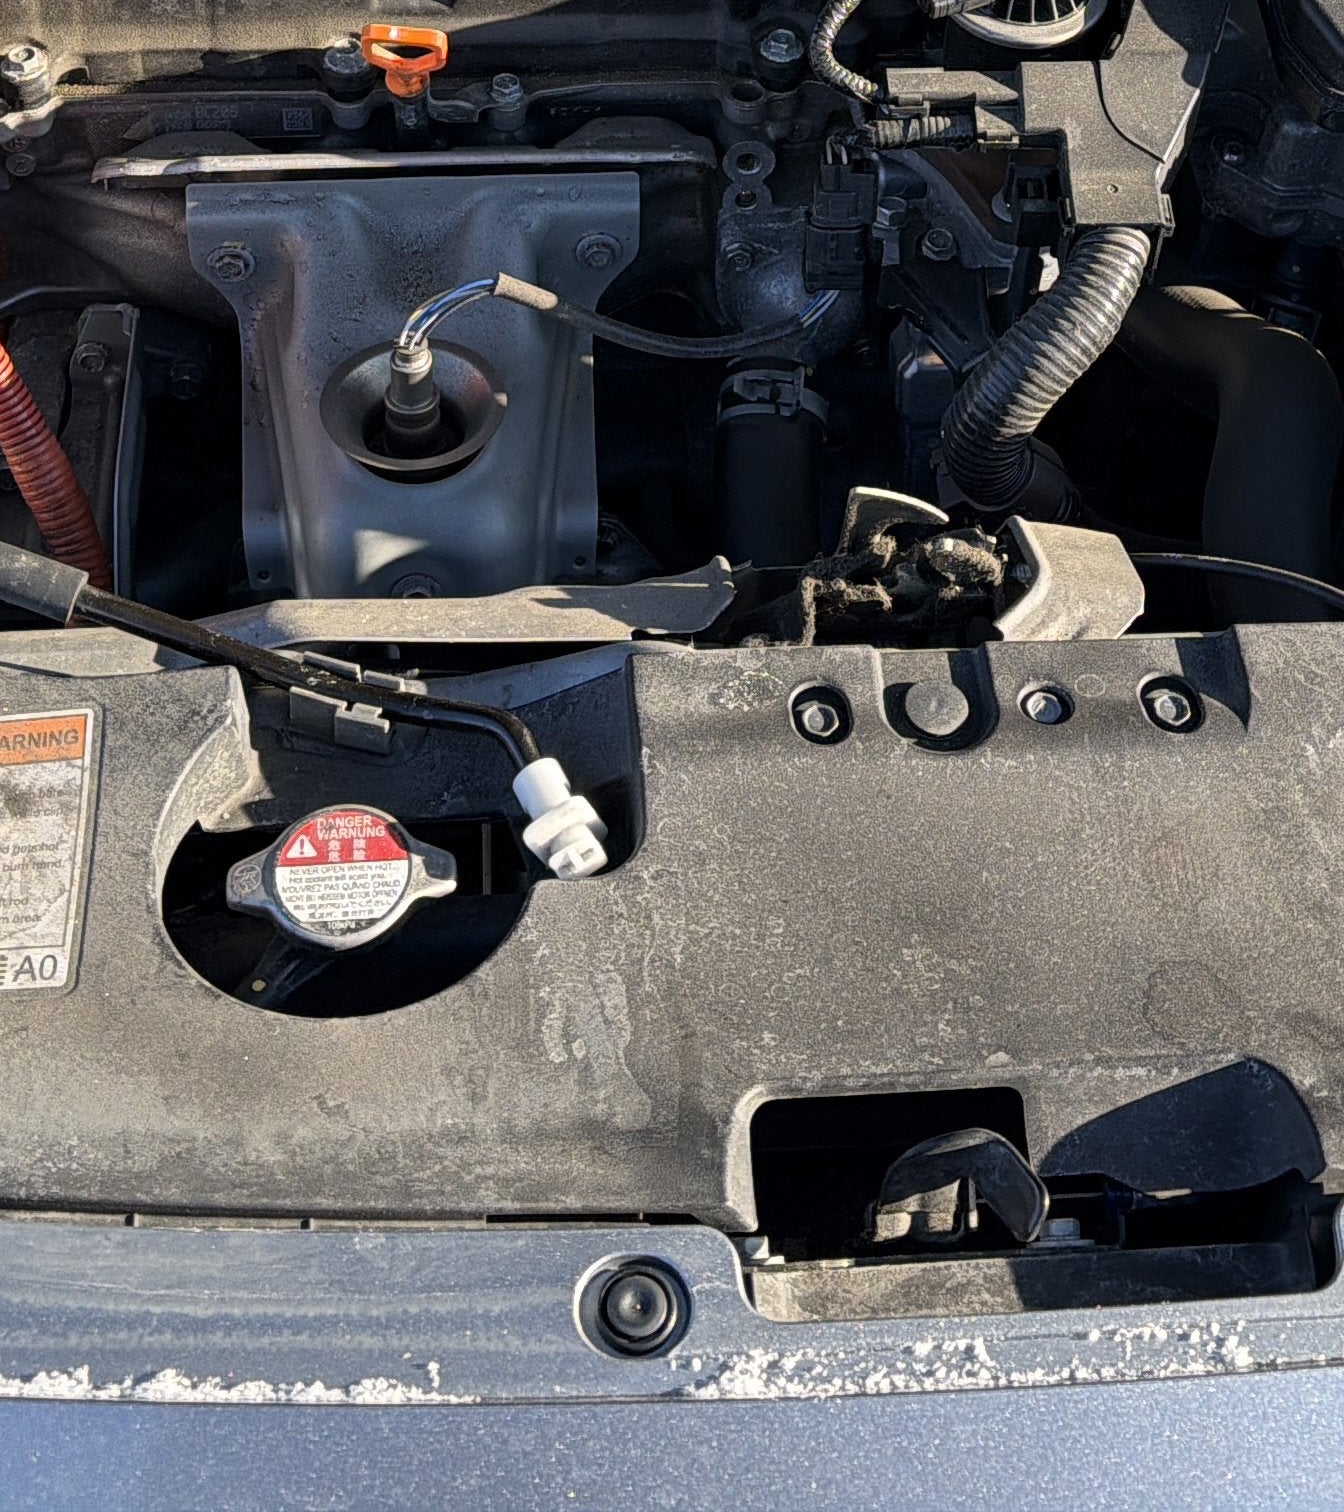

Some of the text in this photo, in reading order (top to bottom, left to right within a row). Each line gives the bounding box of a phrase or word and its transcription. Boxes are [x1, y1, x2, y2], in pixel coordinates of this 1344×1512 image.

[316, 815, 372, 829] DANGER
[317, 826, 385, 840] WARNUNG
[39, 841, 60, 852] hot
[2, 862, 29, 872] burn
[289, 867, 319, 876] NEVER
[321, 865, 345, 874] OPEN
[347, 864, 372, 872] WHEN
[10, 895, 29, 906] rod
